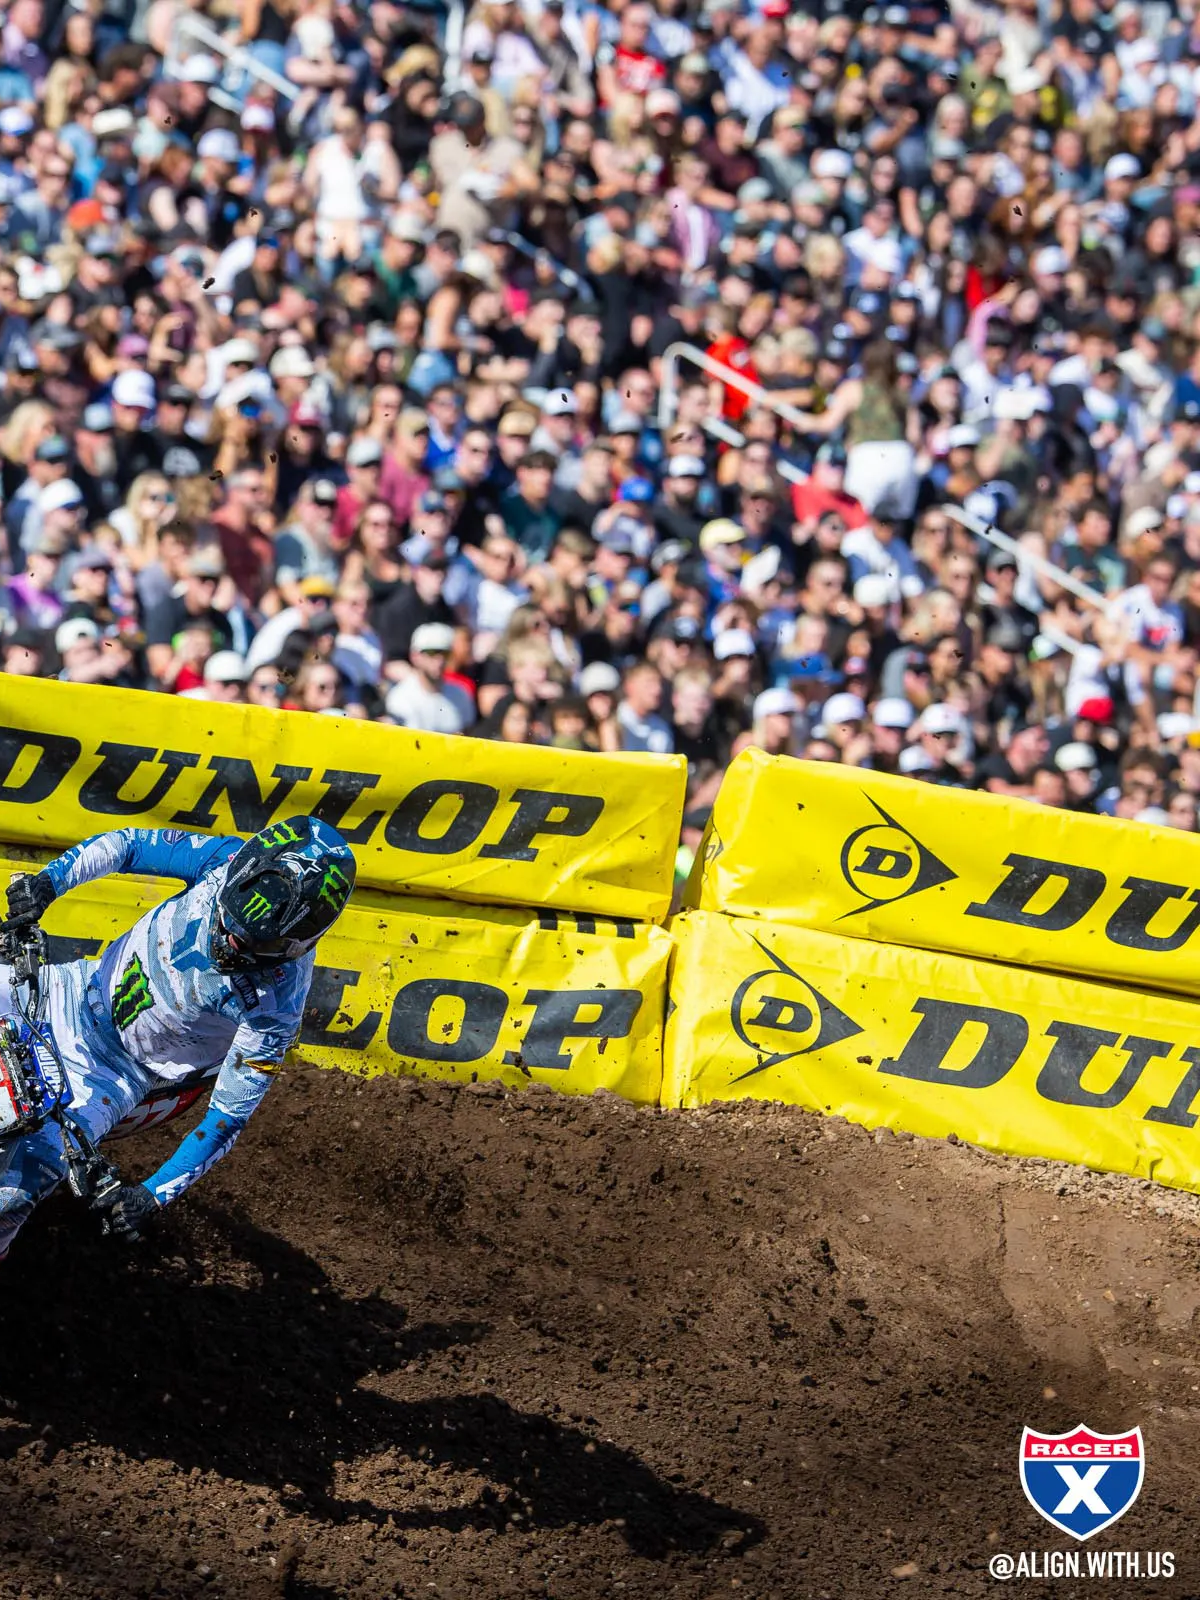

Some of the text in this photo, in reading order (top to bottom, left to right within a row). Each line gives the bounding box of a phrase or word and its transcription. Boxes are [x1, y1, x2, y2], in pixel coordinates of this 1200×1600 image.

[852, 844, 1200, 952] D DU
[746, 995, 814, 1033] D
